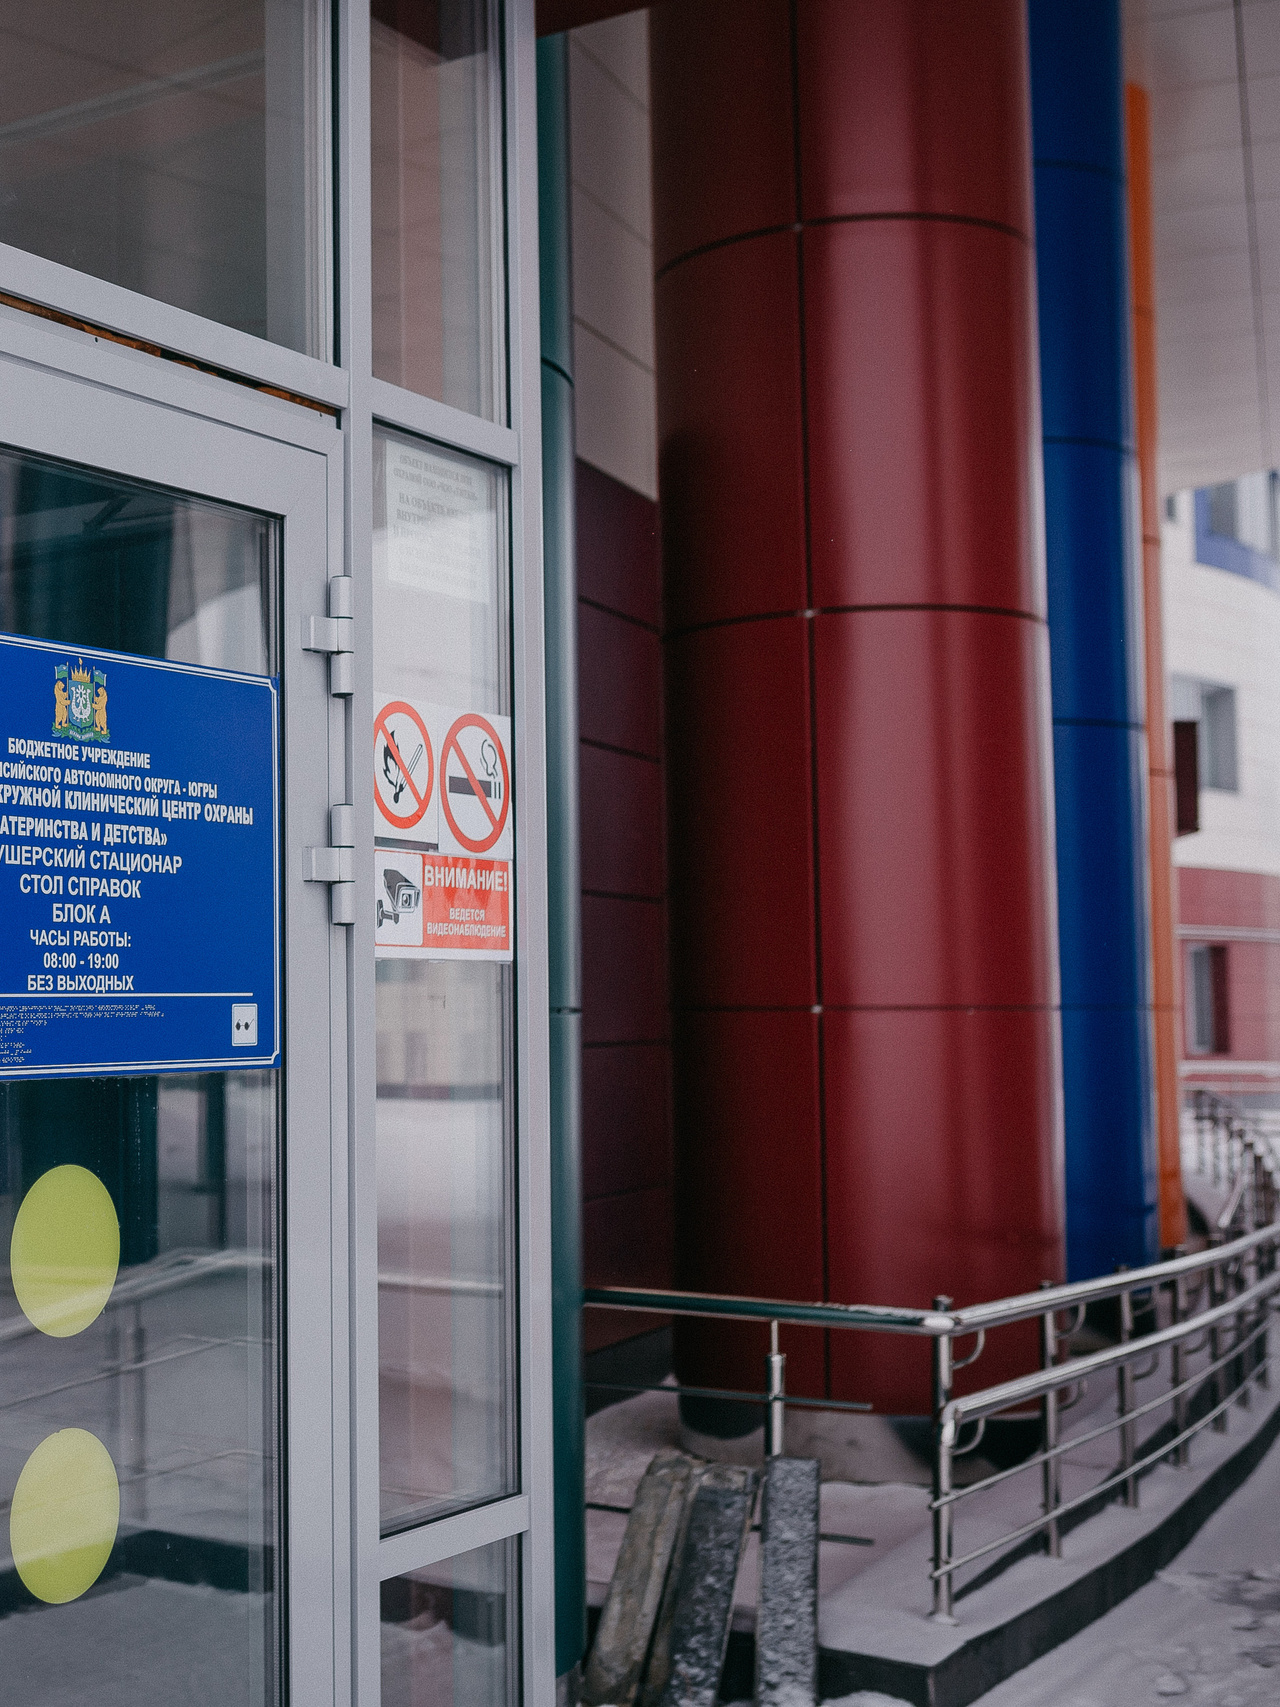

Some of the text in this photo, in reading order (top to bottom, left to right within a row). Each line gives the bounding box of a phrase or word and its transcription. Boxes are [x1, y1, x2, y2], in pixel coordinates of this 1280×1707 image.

[8, 737, 150, 768] БЮДЖЕТНОЕ УЧРЕЖДЕНИЕ
[63, 768, 141, 791] АВТОНОМНОГО
[143, 776, 181, 795] ОКРУГА
[188, 781, 217, 798] ЮГРЫ
[64, 790, 158, 816] КЛИНИЧЕСКИЙ
[162, 799, 201, 821] ЦЕНТР
[204, 803, 253, 825] ОХРАНЫ
[91, 822, 100, 841] И
[103, 823, 167, 846] ДЕТСТВА»
[89, 850, 182, 874] СТАЦИОНАР
[19, 873, 141, 898] СТОЛ СПРАВОК
[424, 865, 507, 891] ВНИМАНИЕ!
[52, 902, 111, 923] БЛОК А
[449, 907, 485, 922] ВЕДЕТСЯ
[29, 929, 131, 947] ЧАСЫ РАБОТЫ:
[426, 921, 506, 938] ВИДЕОНАБЛЮДЕНИЕ
[43, 952, 76, 968] 08:00
[87, 952, 119, 969] 19:00
[27, 975, 134, 994] БЕЗ ВЫХОДНЫХ
